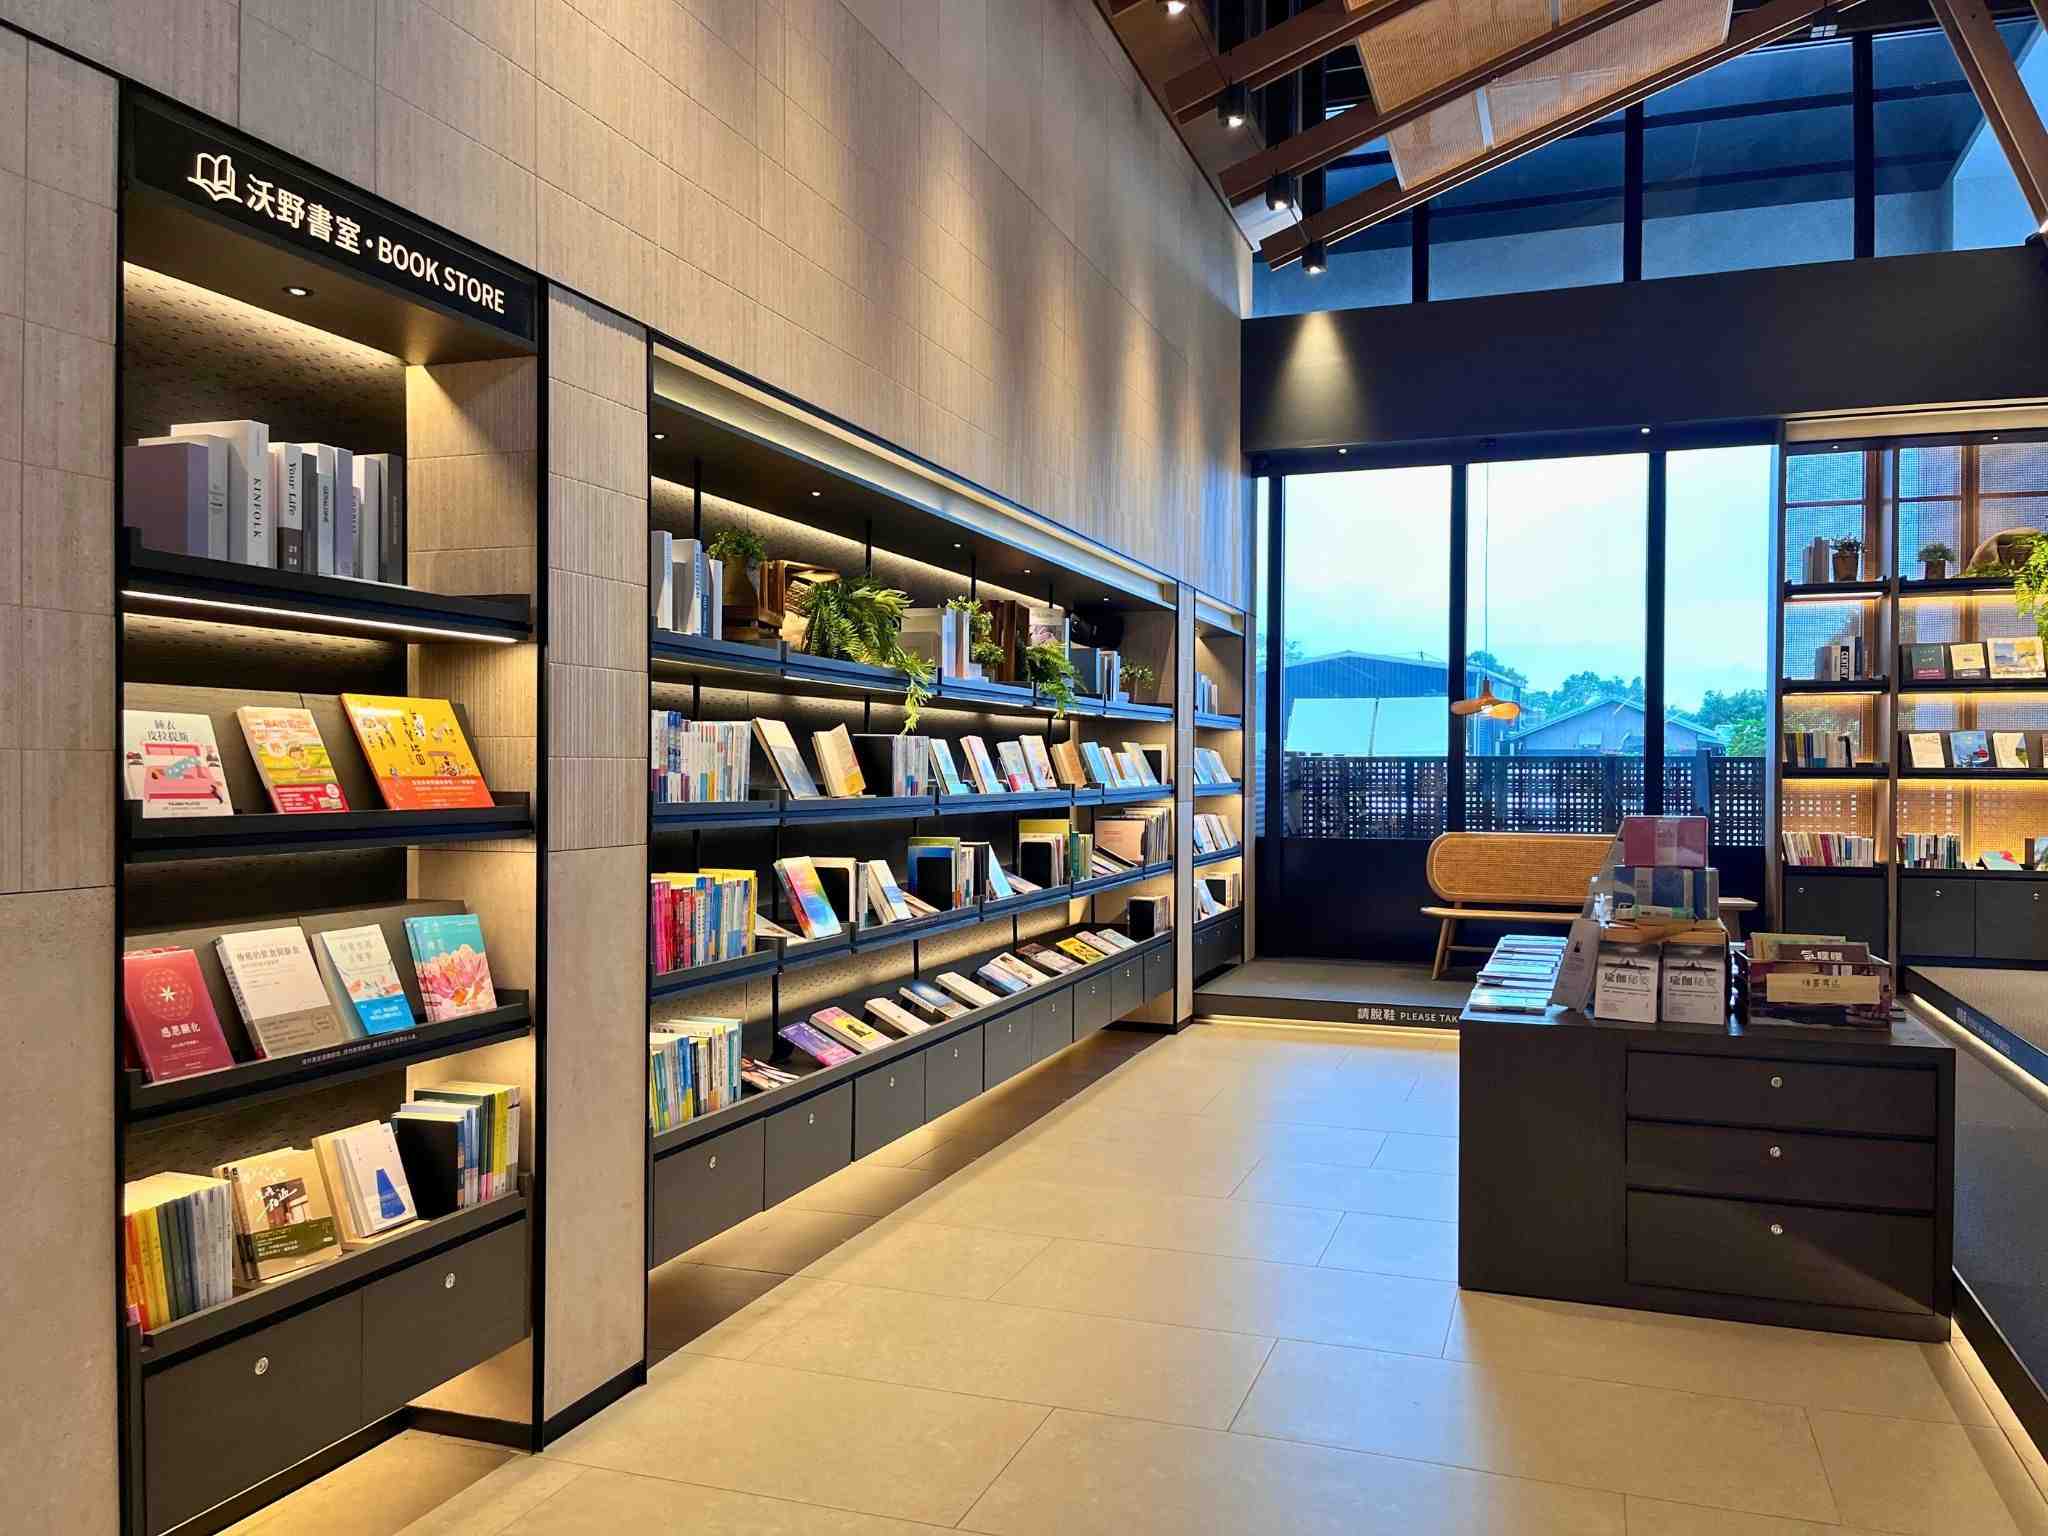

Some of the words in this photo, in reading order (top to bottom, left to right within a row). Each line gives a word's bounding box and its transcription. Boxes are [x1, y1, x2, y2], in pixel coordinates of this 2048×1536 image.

[246, 174, 361, 255] 沃野書室
[378, 236, 440, 286] BOOK
[444, 266, 505, 314] STORE
[289, 462, 297, 490] Your
[253, 478, 262, 537] KINFOLK
[1400, 1011, 1437, 1022] PLEASE
[1439, 1014, 1458, 1023] TAK
